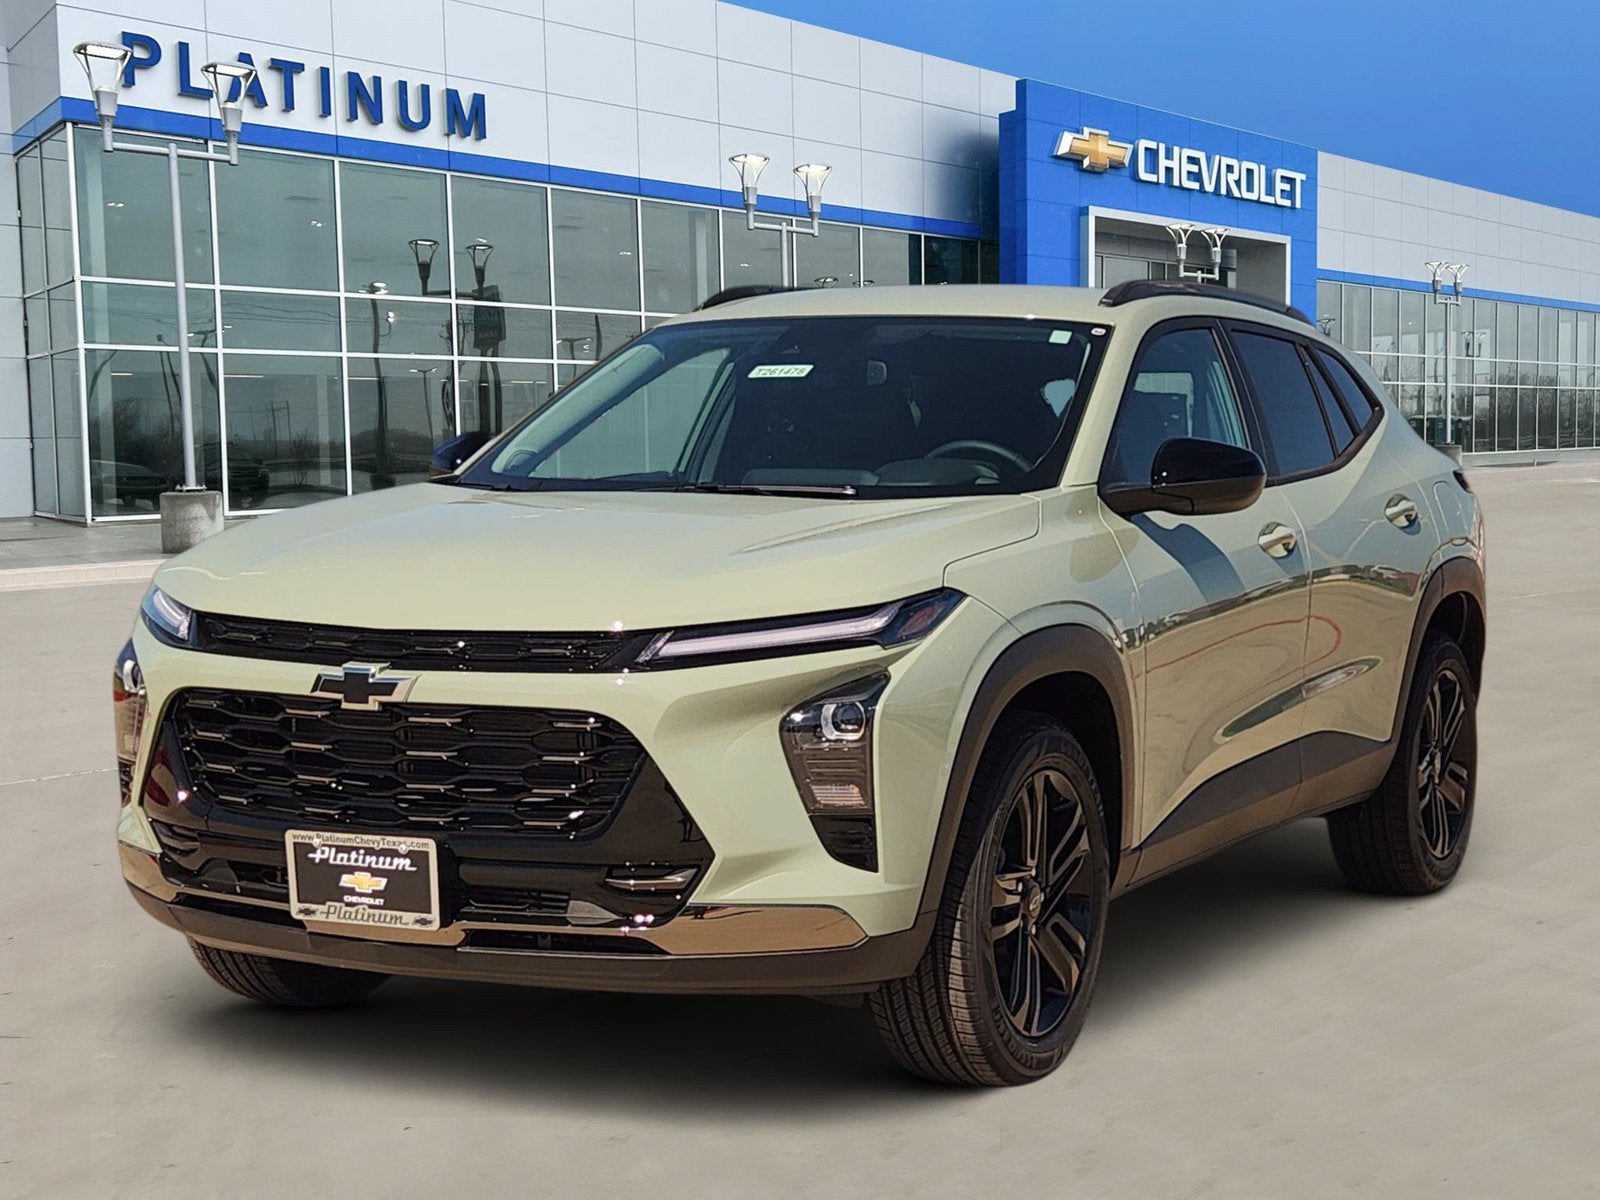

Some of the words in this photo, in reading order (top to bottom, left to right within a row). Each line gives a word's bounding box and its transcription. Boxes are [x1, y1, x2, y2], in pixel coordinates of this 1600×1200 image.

[120, 31, 487, 140] PLATINUM
[1137, 138, 1306, 209] CHEVROLET
[292, 833, 429, 849] wwwPlatinumChevyTexa.com
[307, 847, 417, 871] Platinum
[320, 904, 409, 926] Platinum
